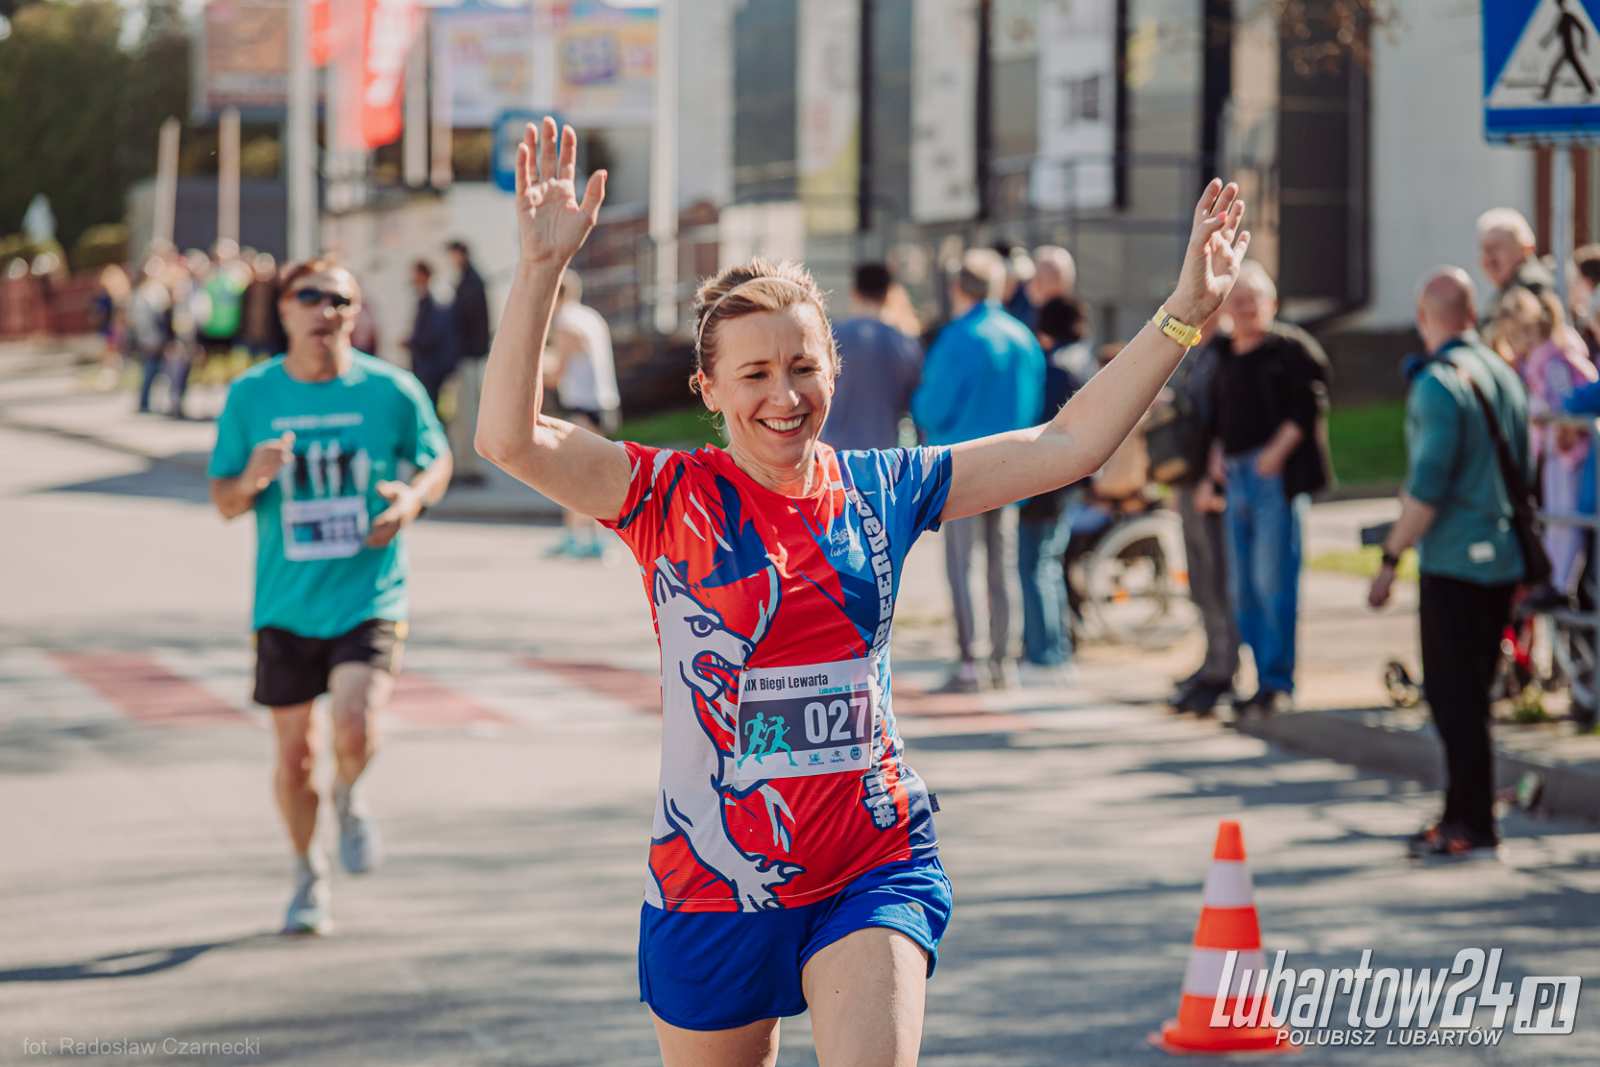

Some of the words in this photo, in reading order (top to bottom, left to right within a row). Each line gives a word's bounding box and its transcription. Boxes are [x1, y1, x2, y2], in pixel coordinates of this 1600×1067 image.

[760, 676, 785, 692] Biegi
[788, 673, 829, 689] Lewarta
[804, 696, 869, 744] 027
